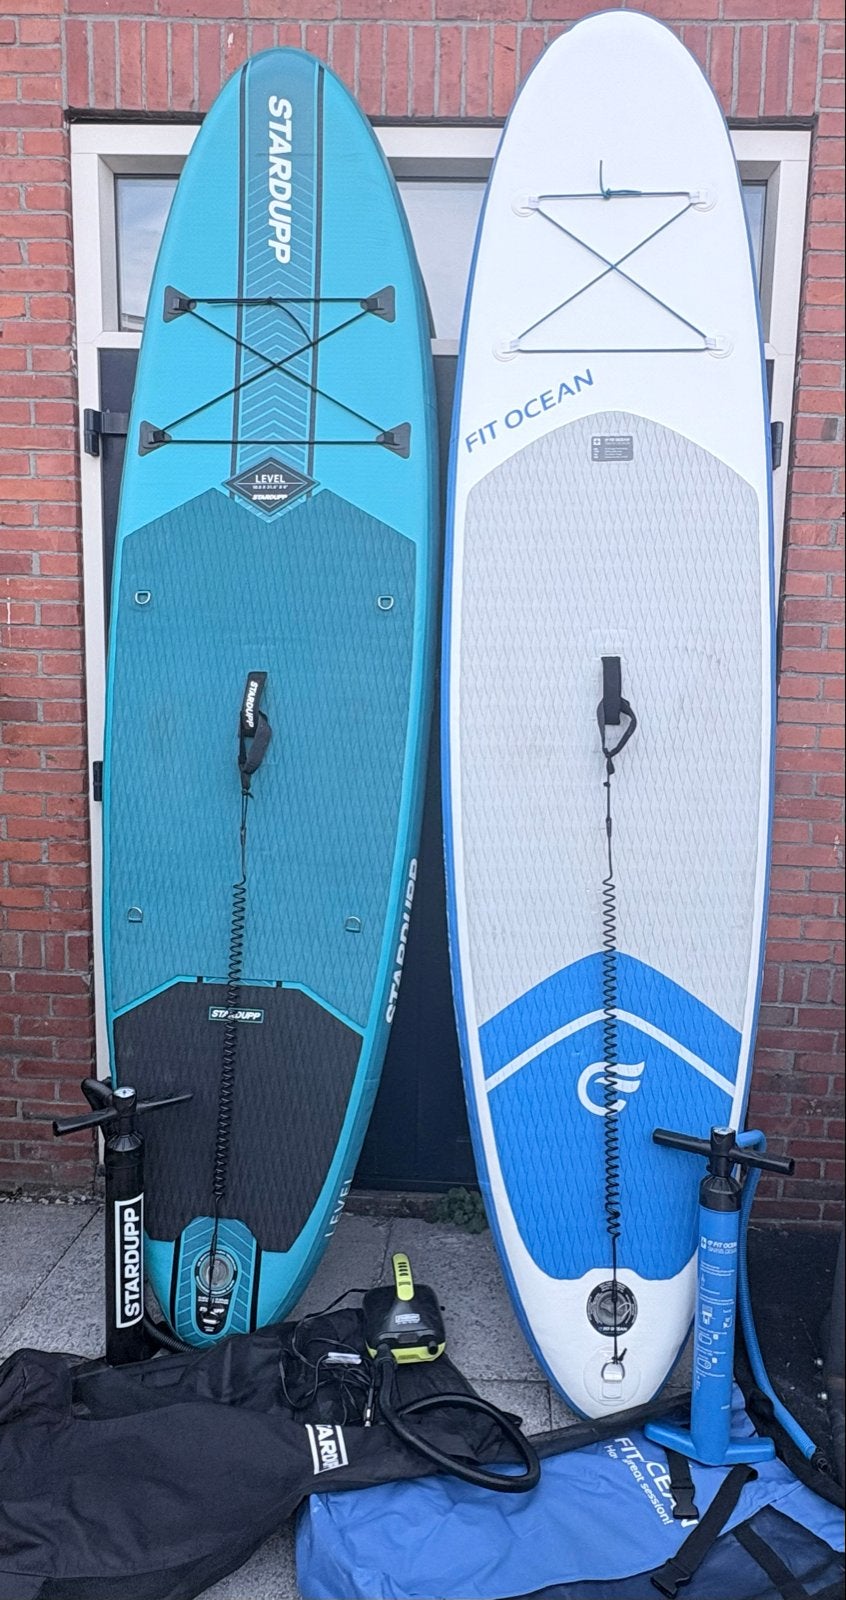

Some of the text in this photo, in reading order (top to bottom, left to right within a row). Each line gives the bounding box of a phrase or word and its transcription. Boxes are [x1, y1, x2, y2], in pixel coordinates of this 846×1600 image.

[267, 95, 293, 264] STARDUPP
[465, 368, 594, 453] FIT OCEAN
[255, 474, 285, 483] LEVEL
[245, 681, 259, 728] STARDUPP
[211, 1009, 262, 1020] STADUPP
[123, 1207, 140, 1317] STARDUPP
[614, 1437, 645, 1462] FIT
[640, 1482, 675, 1526] session!
